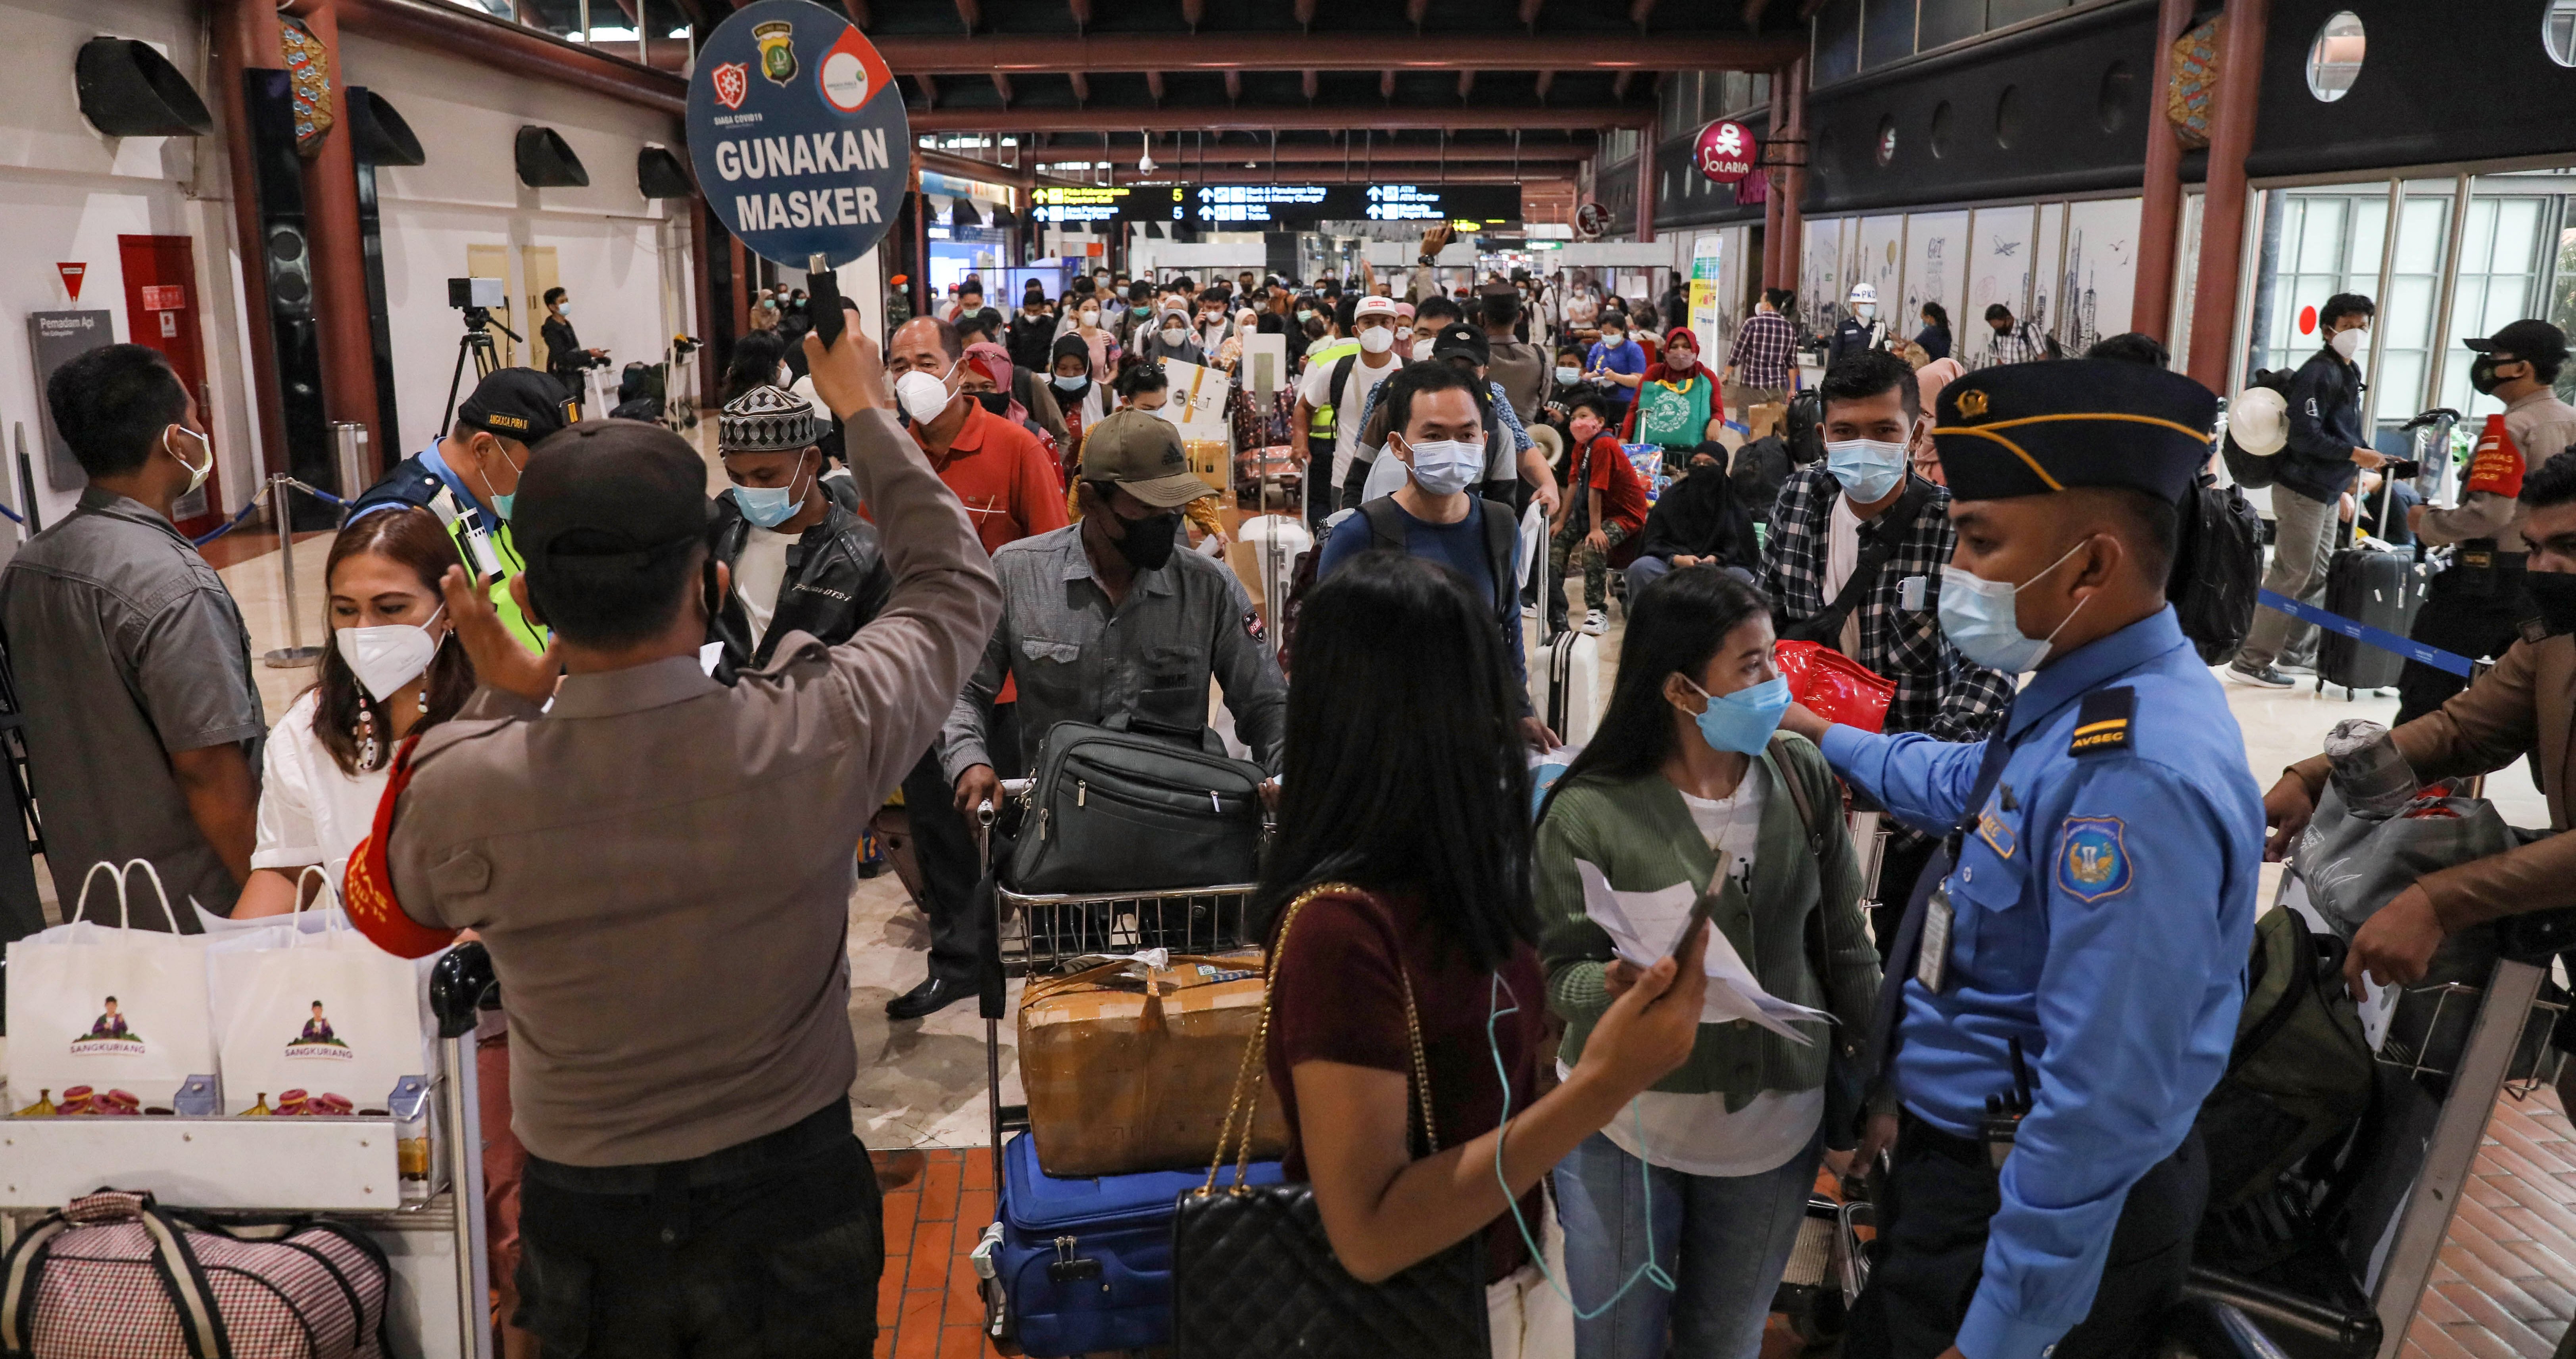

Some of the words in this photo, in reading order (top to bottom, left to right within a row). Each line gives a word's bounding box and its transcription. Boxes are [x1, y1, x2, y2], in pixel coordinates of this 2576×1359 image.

[714, 117, 734, 125] SIAGA
[734, 113, 763, 124] COVID19
[716, 128, 889, 181] GUNAKAN
[1703, 146, 1749, 173] SOLARIA
[1081, 188, 1130, 197] Keberangkatan
[1173, 188, 1183, 202] 5
[1307, 187, 1326, 196] Uang
[1064, 196, 1096, 205] Departure
[1271, 195, 1294, 203] Money
[1295, 194, 1324, 203] Changer
[1416, 193, 1440, 202] Center
[736, 186, 882, 231] MASKER
[1173, 206, 1183, 219] 5
[1399, 211, 1422, 220] Prayer
[40, 318, 80, 329] Pemadam
[489, 414, 510, 427] ANGKASA
[511, 418, 522, 429] PURA
[2071, 731, 2124, 748] AVSEC
[70, 1044, 145, 1054] SANGKURIANG
[286, 1048, 353, 1059] SANGKURIANG
